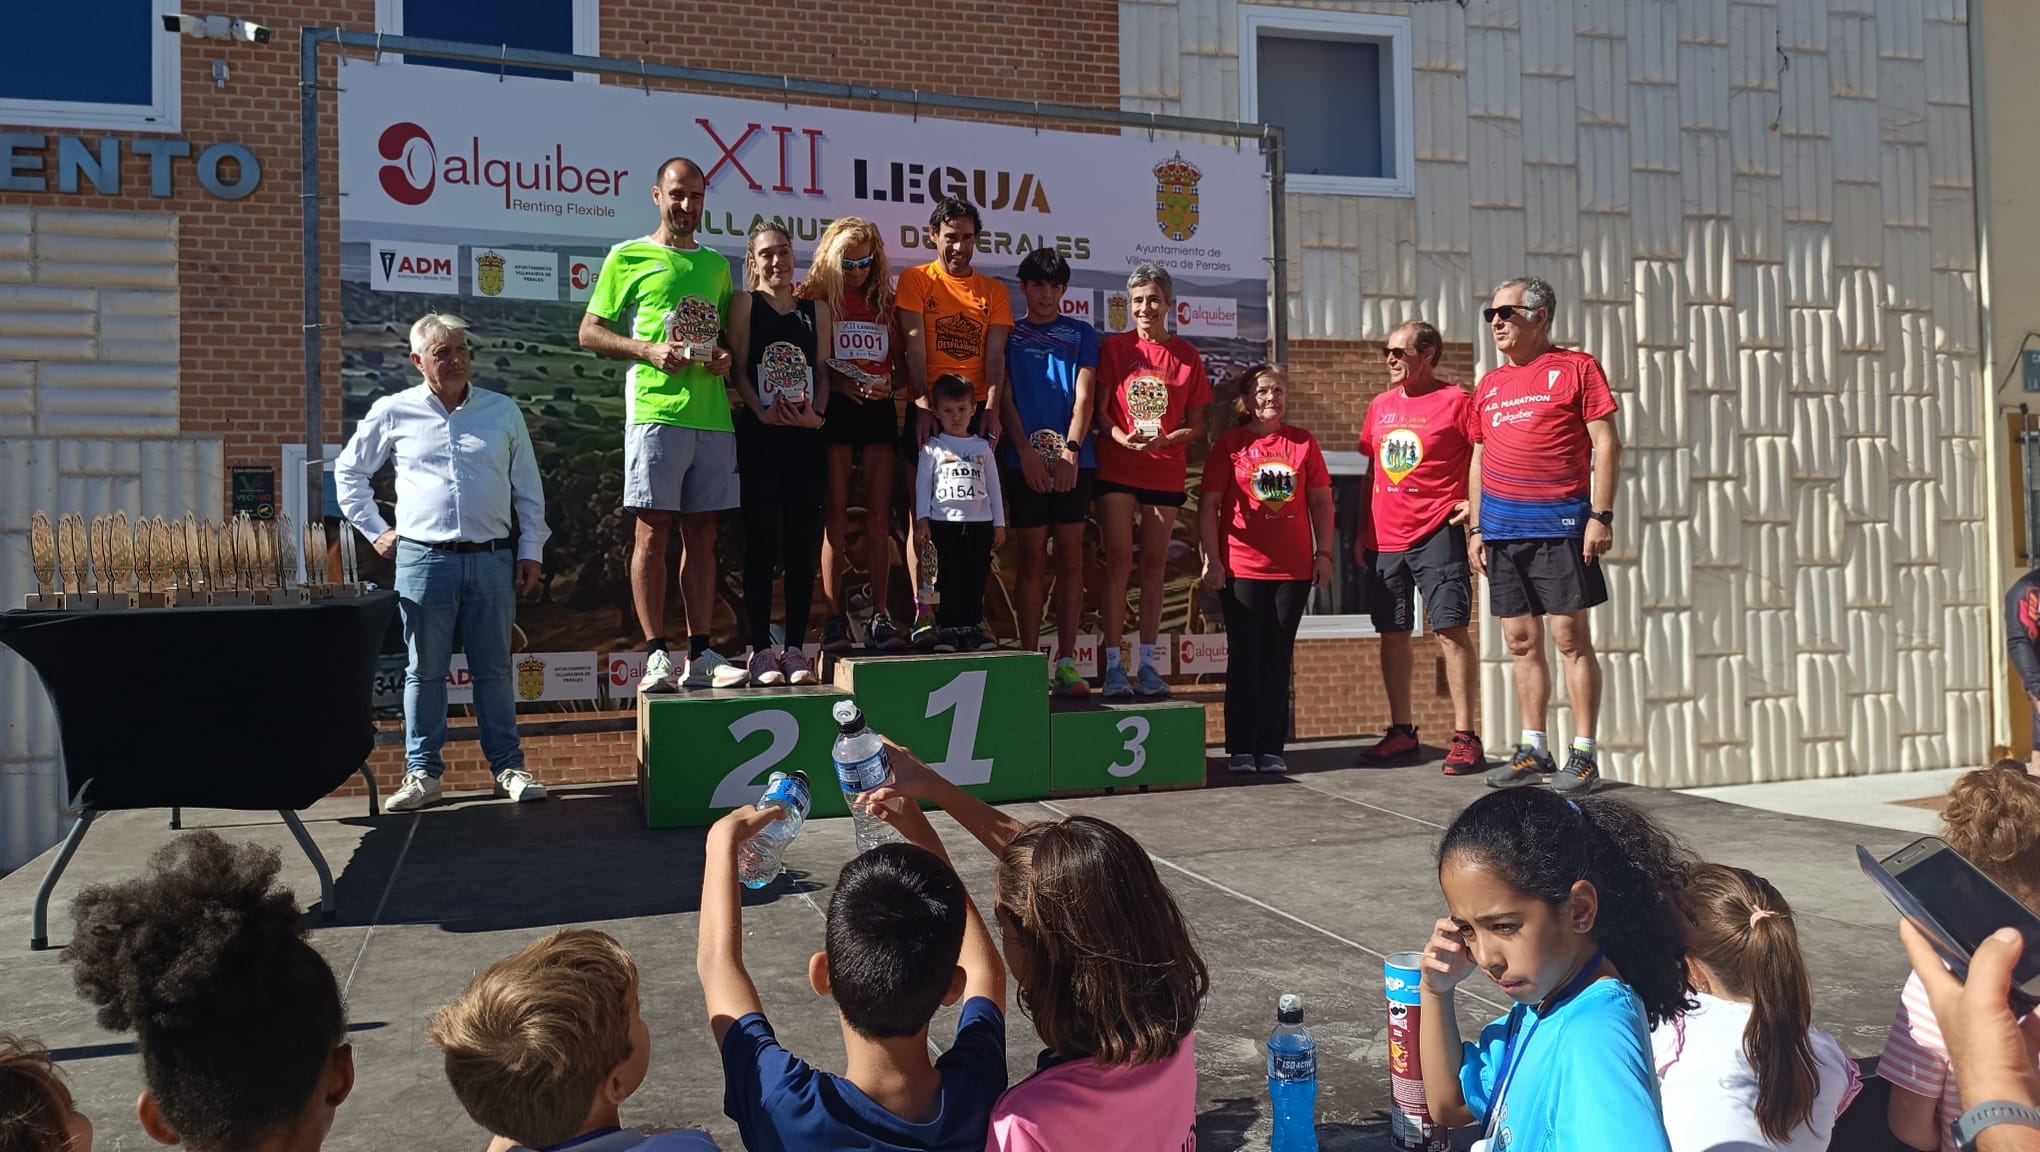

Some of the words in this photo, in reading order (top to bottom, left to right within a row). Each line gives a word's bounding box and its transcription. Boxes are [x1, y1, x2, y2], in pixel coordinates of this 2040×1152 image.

[443, 136, 629, 209] alquiber
[695, 118, 824, 195] XII
[854, 158, 1052, 214] LEGUA
[512, 199, 563, 216] Renting
[567, 202, 616, 218] Flexible
[975, 230, 1091, 260] ERALES
[1135, 243, 1205, 257] Ayuntamiento
[1207, 248, 1222, 257] de
[397, 256, 452, 275] ADM
[1180, 258, 1194, 269] de
[1196, 259, 1232, 271] Perales
[1191, 304, 1236, 325] alquiber
[839, 333, 883, 351] 0001
[1501, 395, 1551, 409] MARATHON
[1502, 409, 1535, 424] alquiber
[924, 670, 994, 786] 1
[1107, 716, 1151, 778] 3
[709, 709, 800, 808] 2
